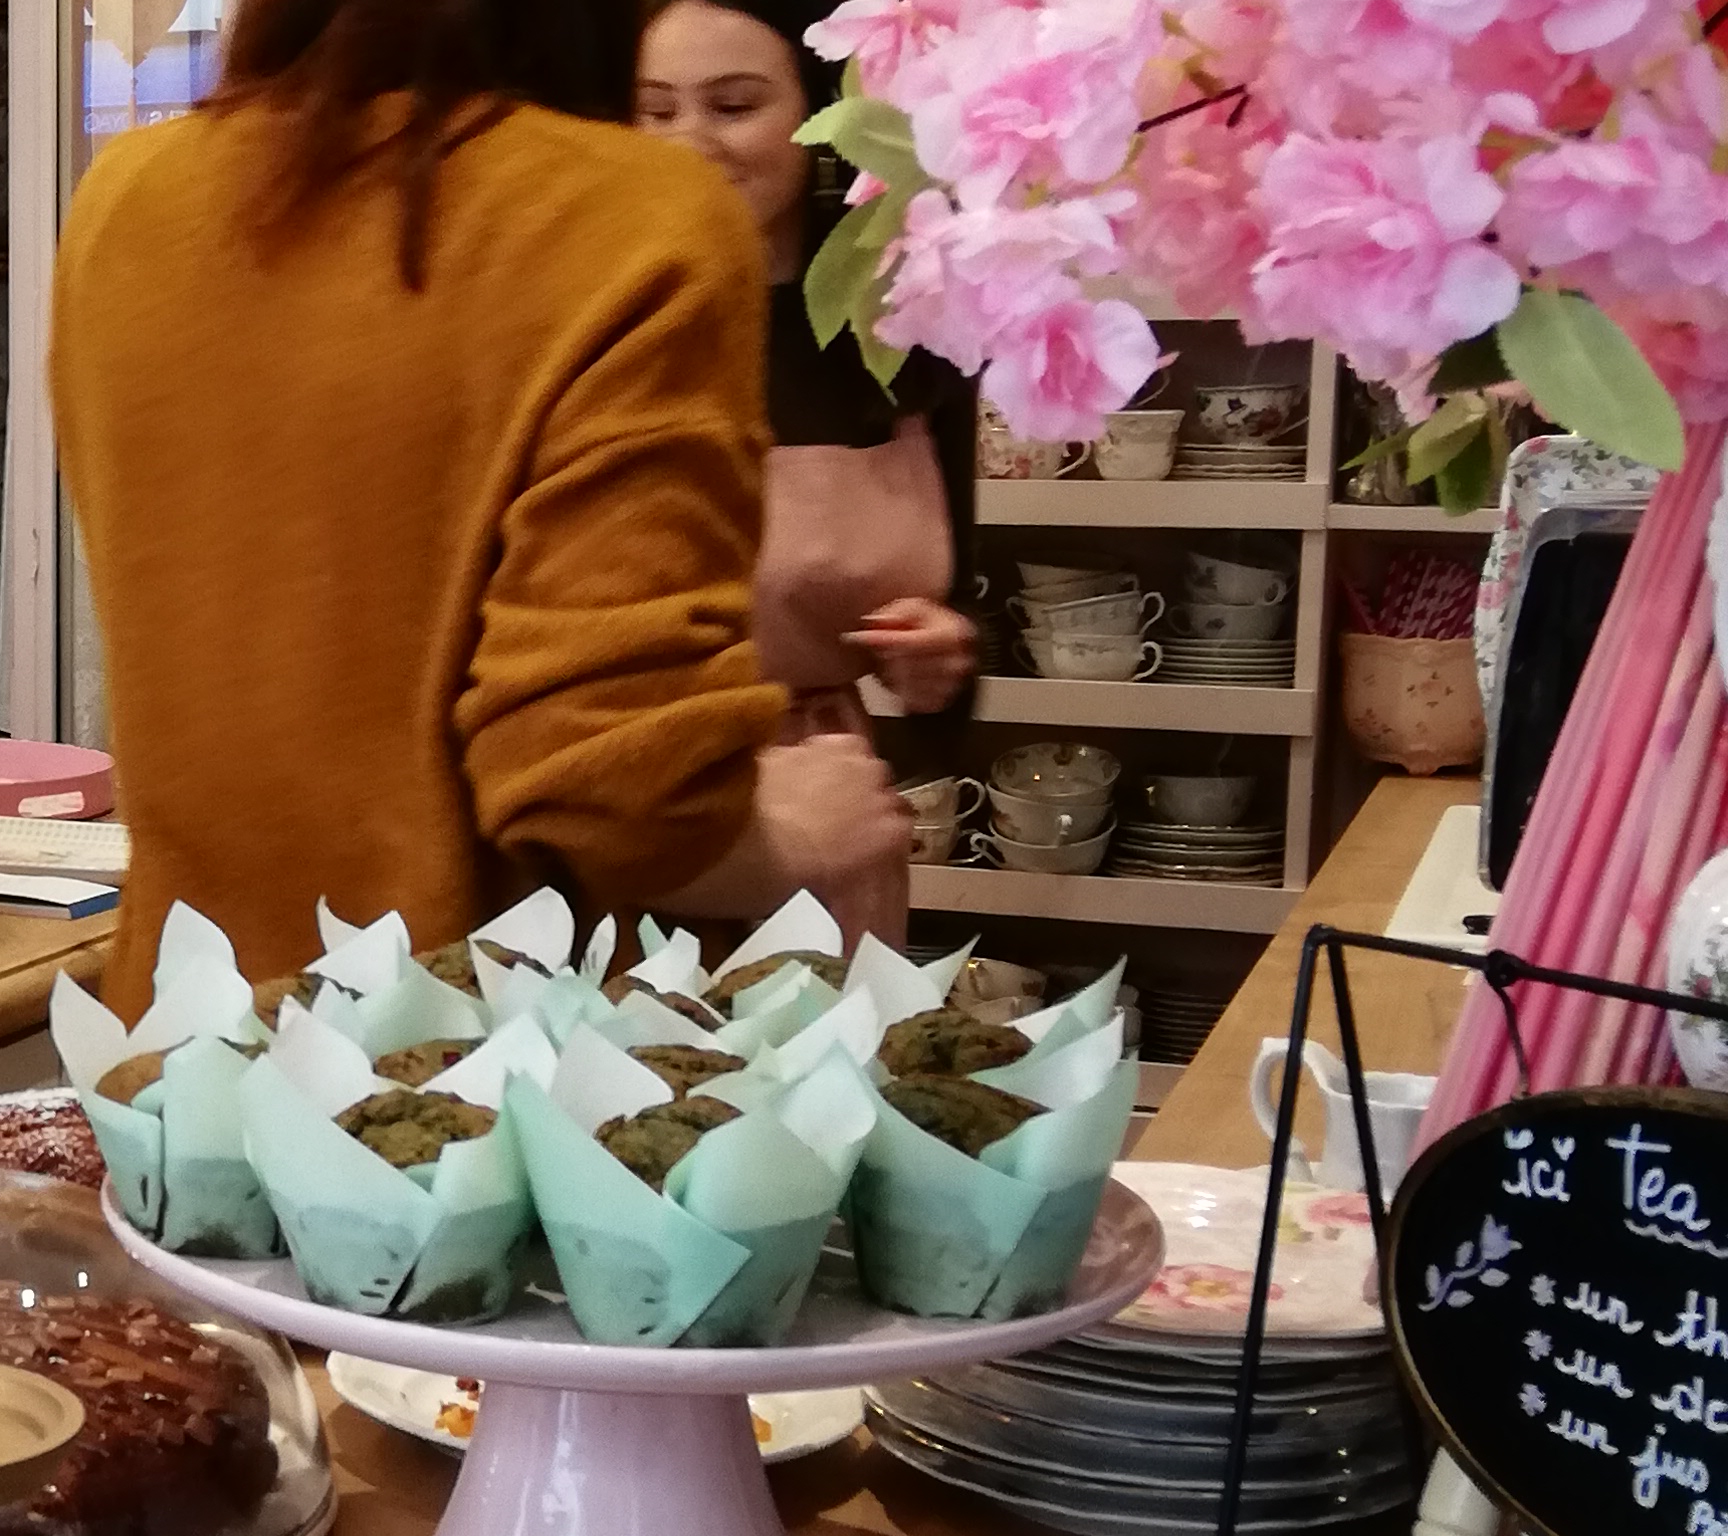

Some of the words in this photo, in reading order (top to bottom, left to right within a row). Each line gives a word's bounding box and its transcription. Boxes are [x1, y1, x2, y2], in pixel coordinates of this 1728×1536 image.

[1501, 1128, 1576, 1203] ici
[1563, 1281, 1645, 1334] un
[1554, 1348, 1635, 1399] un
[1546, 1409, 1620, 1456] un
[1628, 1423, 1710, 1509] jus
